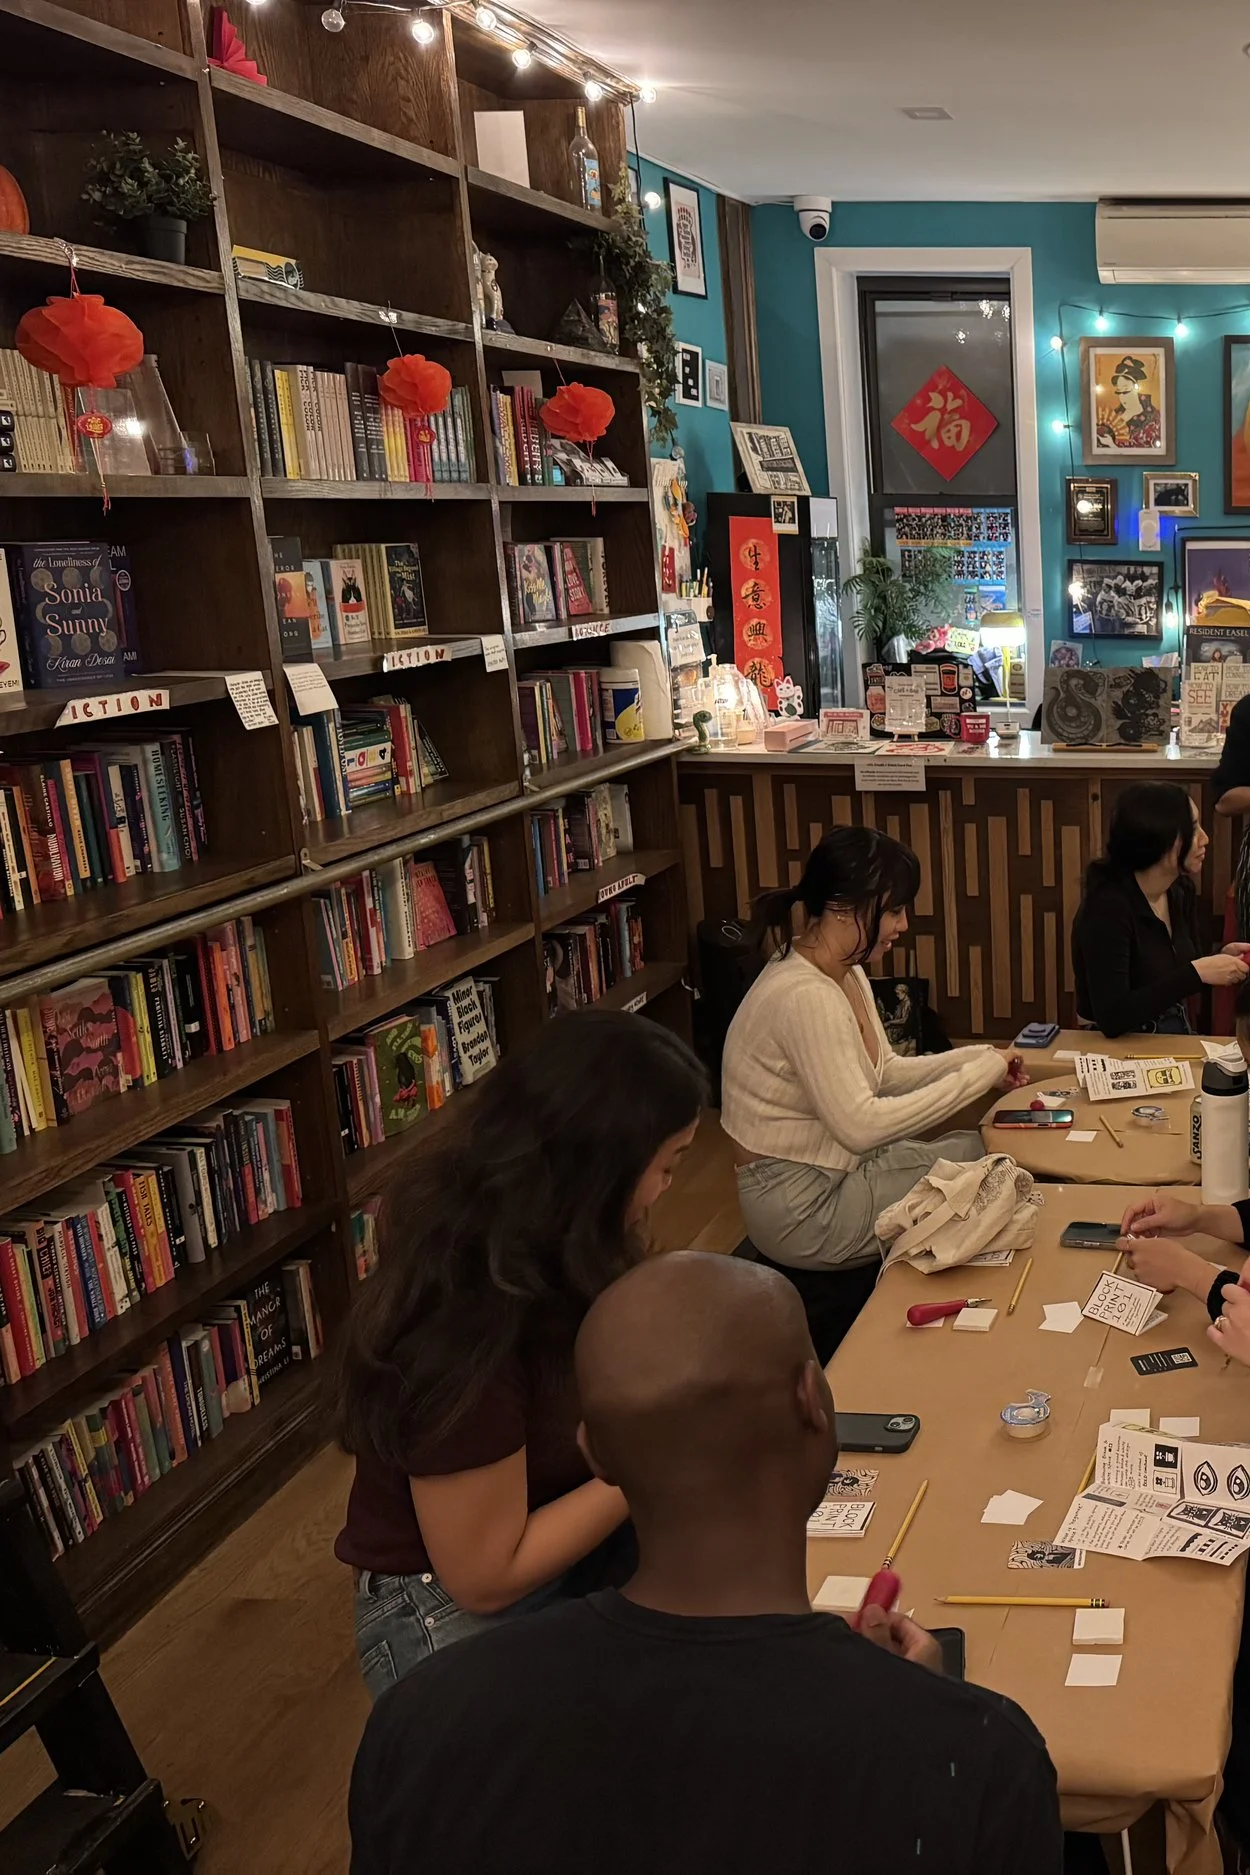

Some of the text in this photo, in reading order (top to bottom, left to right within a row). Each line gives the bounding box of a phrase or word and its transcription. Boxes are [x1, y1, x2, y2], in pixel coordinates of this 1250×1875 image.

[911, 391, 971, 452] 福
[48, 556, 91, 568] Loneliness
[44, 581, 103, 605] Sonia
[45, 613, 108, 637] Sunny
[1189, 627, 1249, 637] RESIDENT EASEL
[46, 653, 115, 673] Kiran Desai
[1193, 671, 1220, 681] EAT
[71, 693, 163, 720] ICTION
[1187, 689, 1213, 705] SEE
[151, 750, 171, 821] HOMESEEKING
[40, 774, 54, 828] ELAINE CASTILLO
[179, 807, 193, 860] SUSAN CHOI
[46, 833, 65, 882] MODERATION
[600, 884, 618, 899] OUNG
[452, 985, 473, 1006] Minor
[456, 1001, 478, 1019] Black
[457, 1012, 483, 1035] Figures
[461, 1030, 489, 1055] Brandon
[468, 1046, 490, 1067] Taylor
[1192, 1115, 1201, 1160] SANZO
[138, 1180, 153, 1227] FISH TALES
[35, 1229, 48, 1247] BIG
[39, 1248, 52, 1276] CHIEF
[254, 1281, 271, 1301] THE
[1088, 1280, 1116, 1316] BLOCK
[1099, 1283, 1125, 1320] PRINT
[250, 1296, 281, 1326] MANOR
[260, 1324, 274, 1341] OF
[254, 1336, 288, 1369] DREAMS
[284, 1356, 290, 1366] LI
[820, 1503, 848, 1528] PRINT
[838, 1503, 866, 1529] BLOCK
